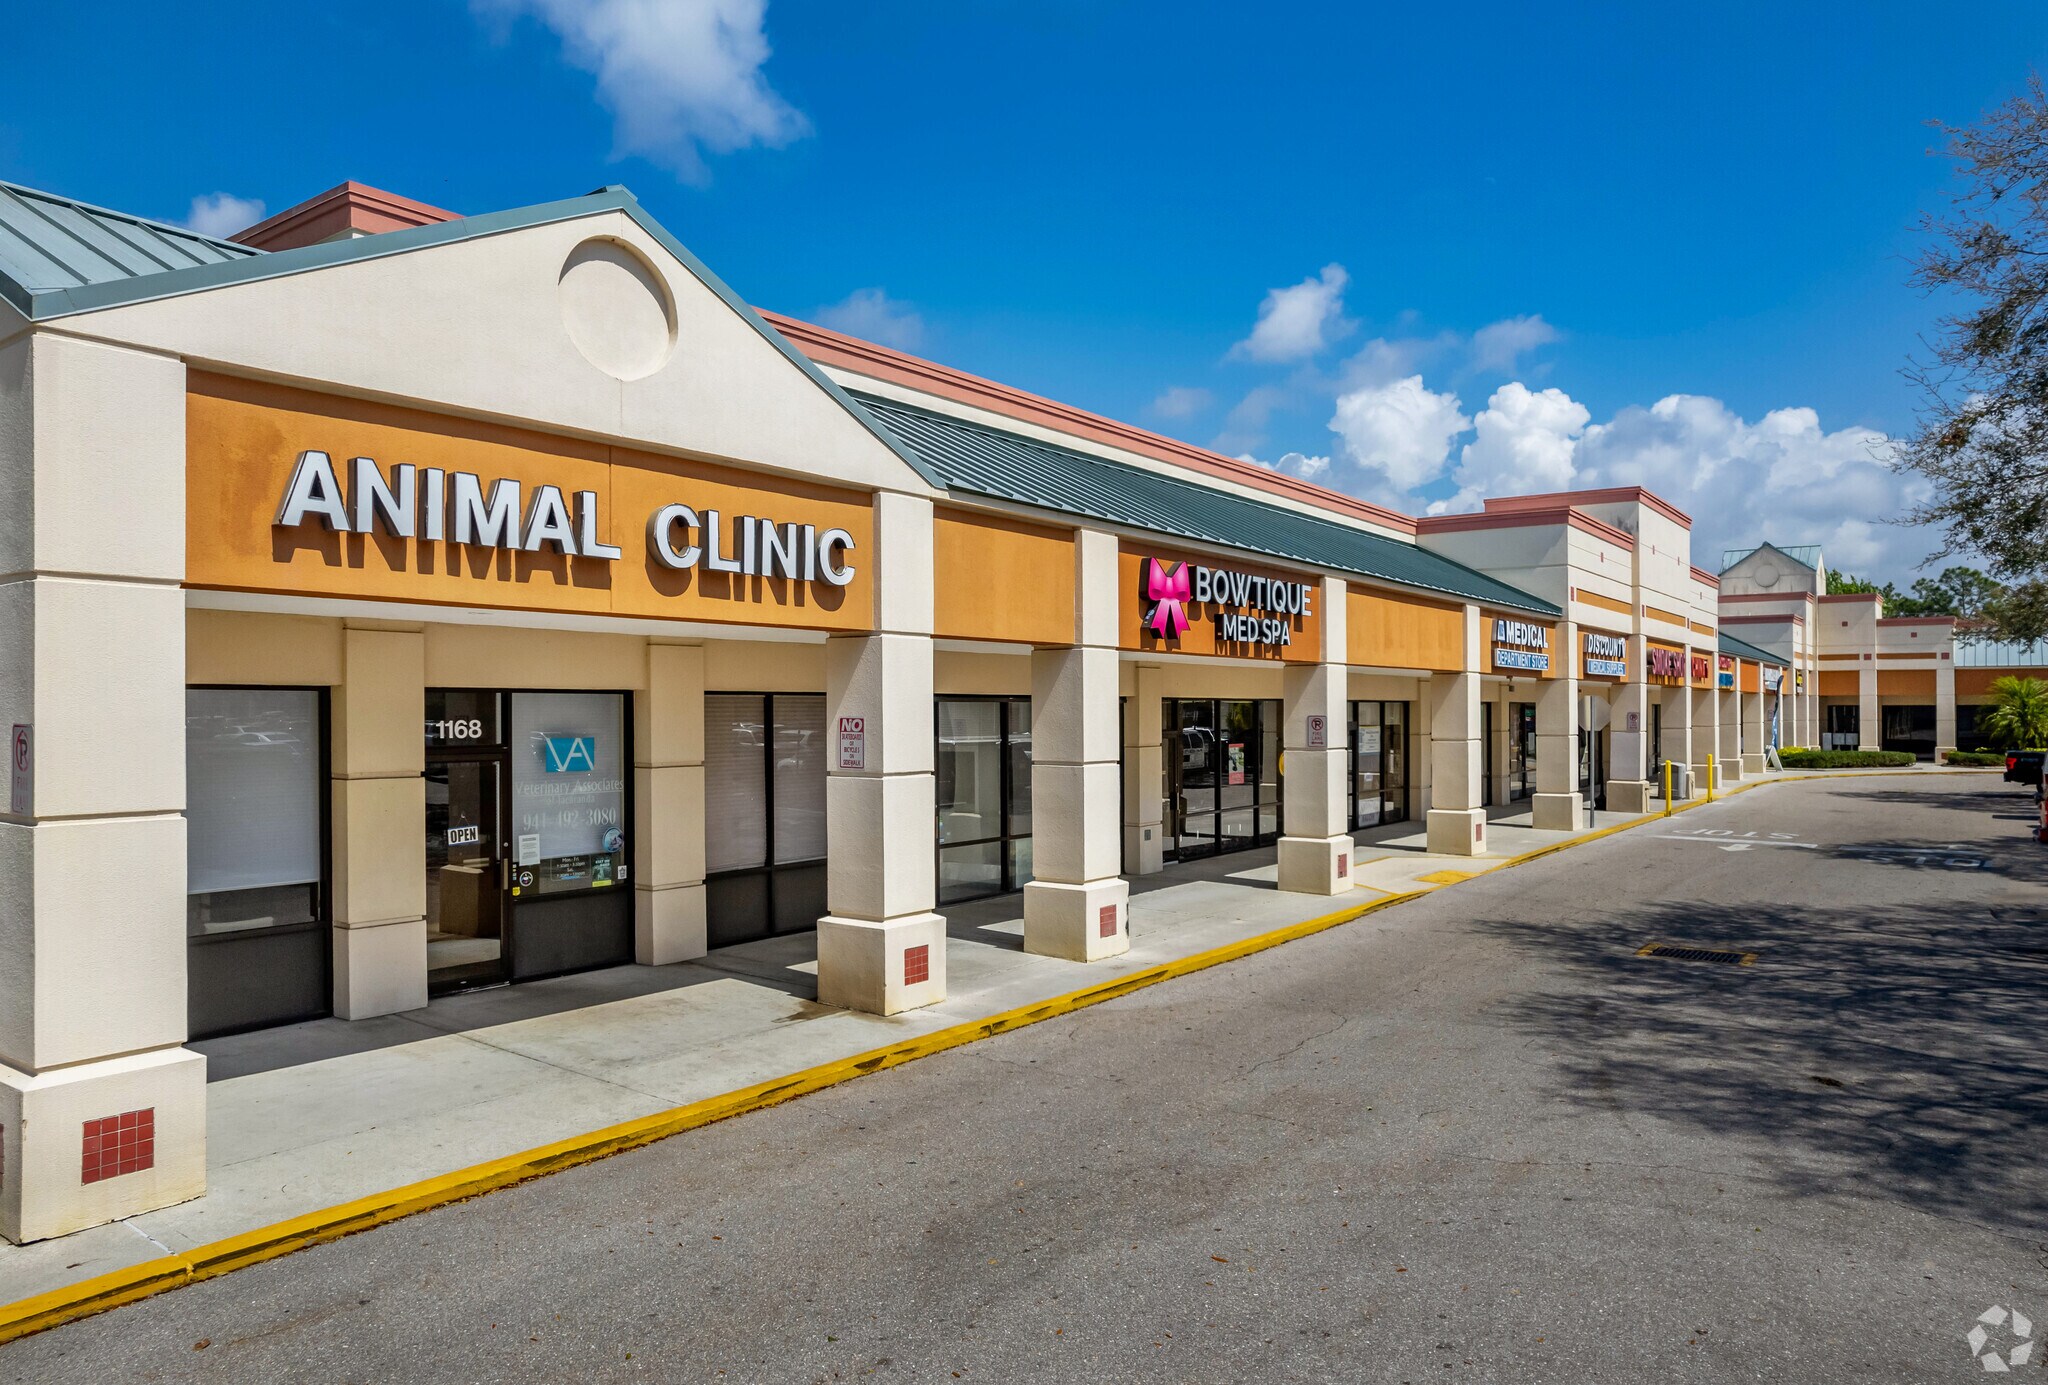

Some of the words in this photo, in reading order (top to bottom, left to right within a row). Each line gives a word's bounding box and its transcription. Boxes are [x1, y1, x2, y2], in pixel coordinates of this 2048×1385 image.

[275, 450, 622, 560] ANIMAL
[647, 503, 856, 587] CLINIC
[1196, 565, 1312, 616] BOWTIQUE
[1223, 614, 1259, 642] MED
[1262, 619, 1292, 646] SPA
[1506, 620, 1548, 648] MEDICAL
[1498, 650, 1531, 667] DEPARTMENT
[1532, 655, 1548, 669] STORE
[436, 719, 482, 739] 1168
[841, 719, 863, 732] NO
[516, 782, 570, 796] Veterinary
[573, 778, 624, 792] Associates
[450, 827, 477, 843] OPEN
[1672, 829, 1800, 839] STOP
